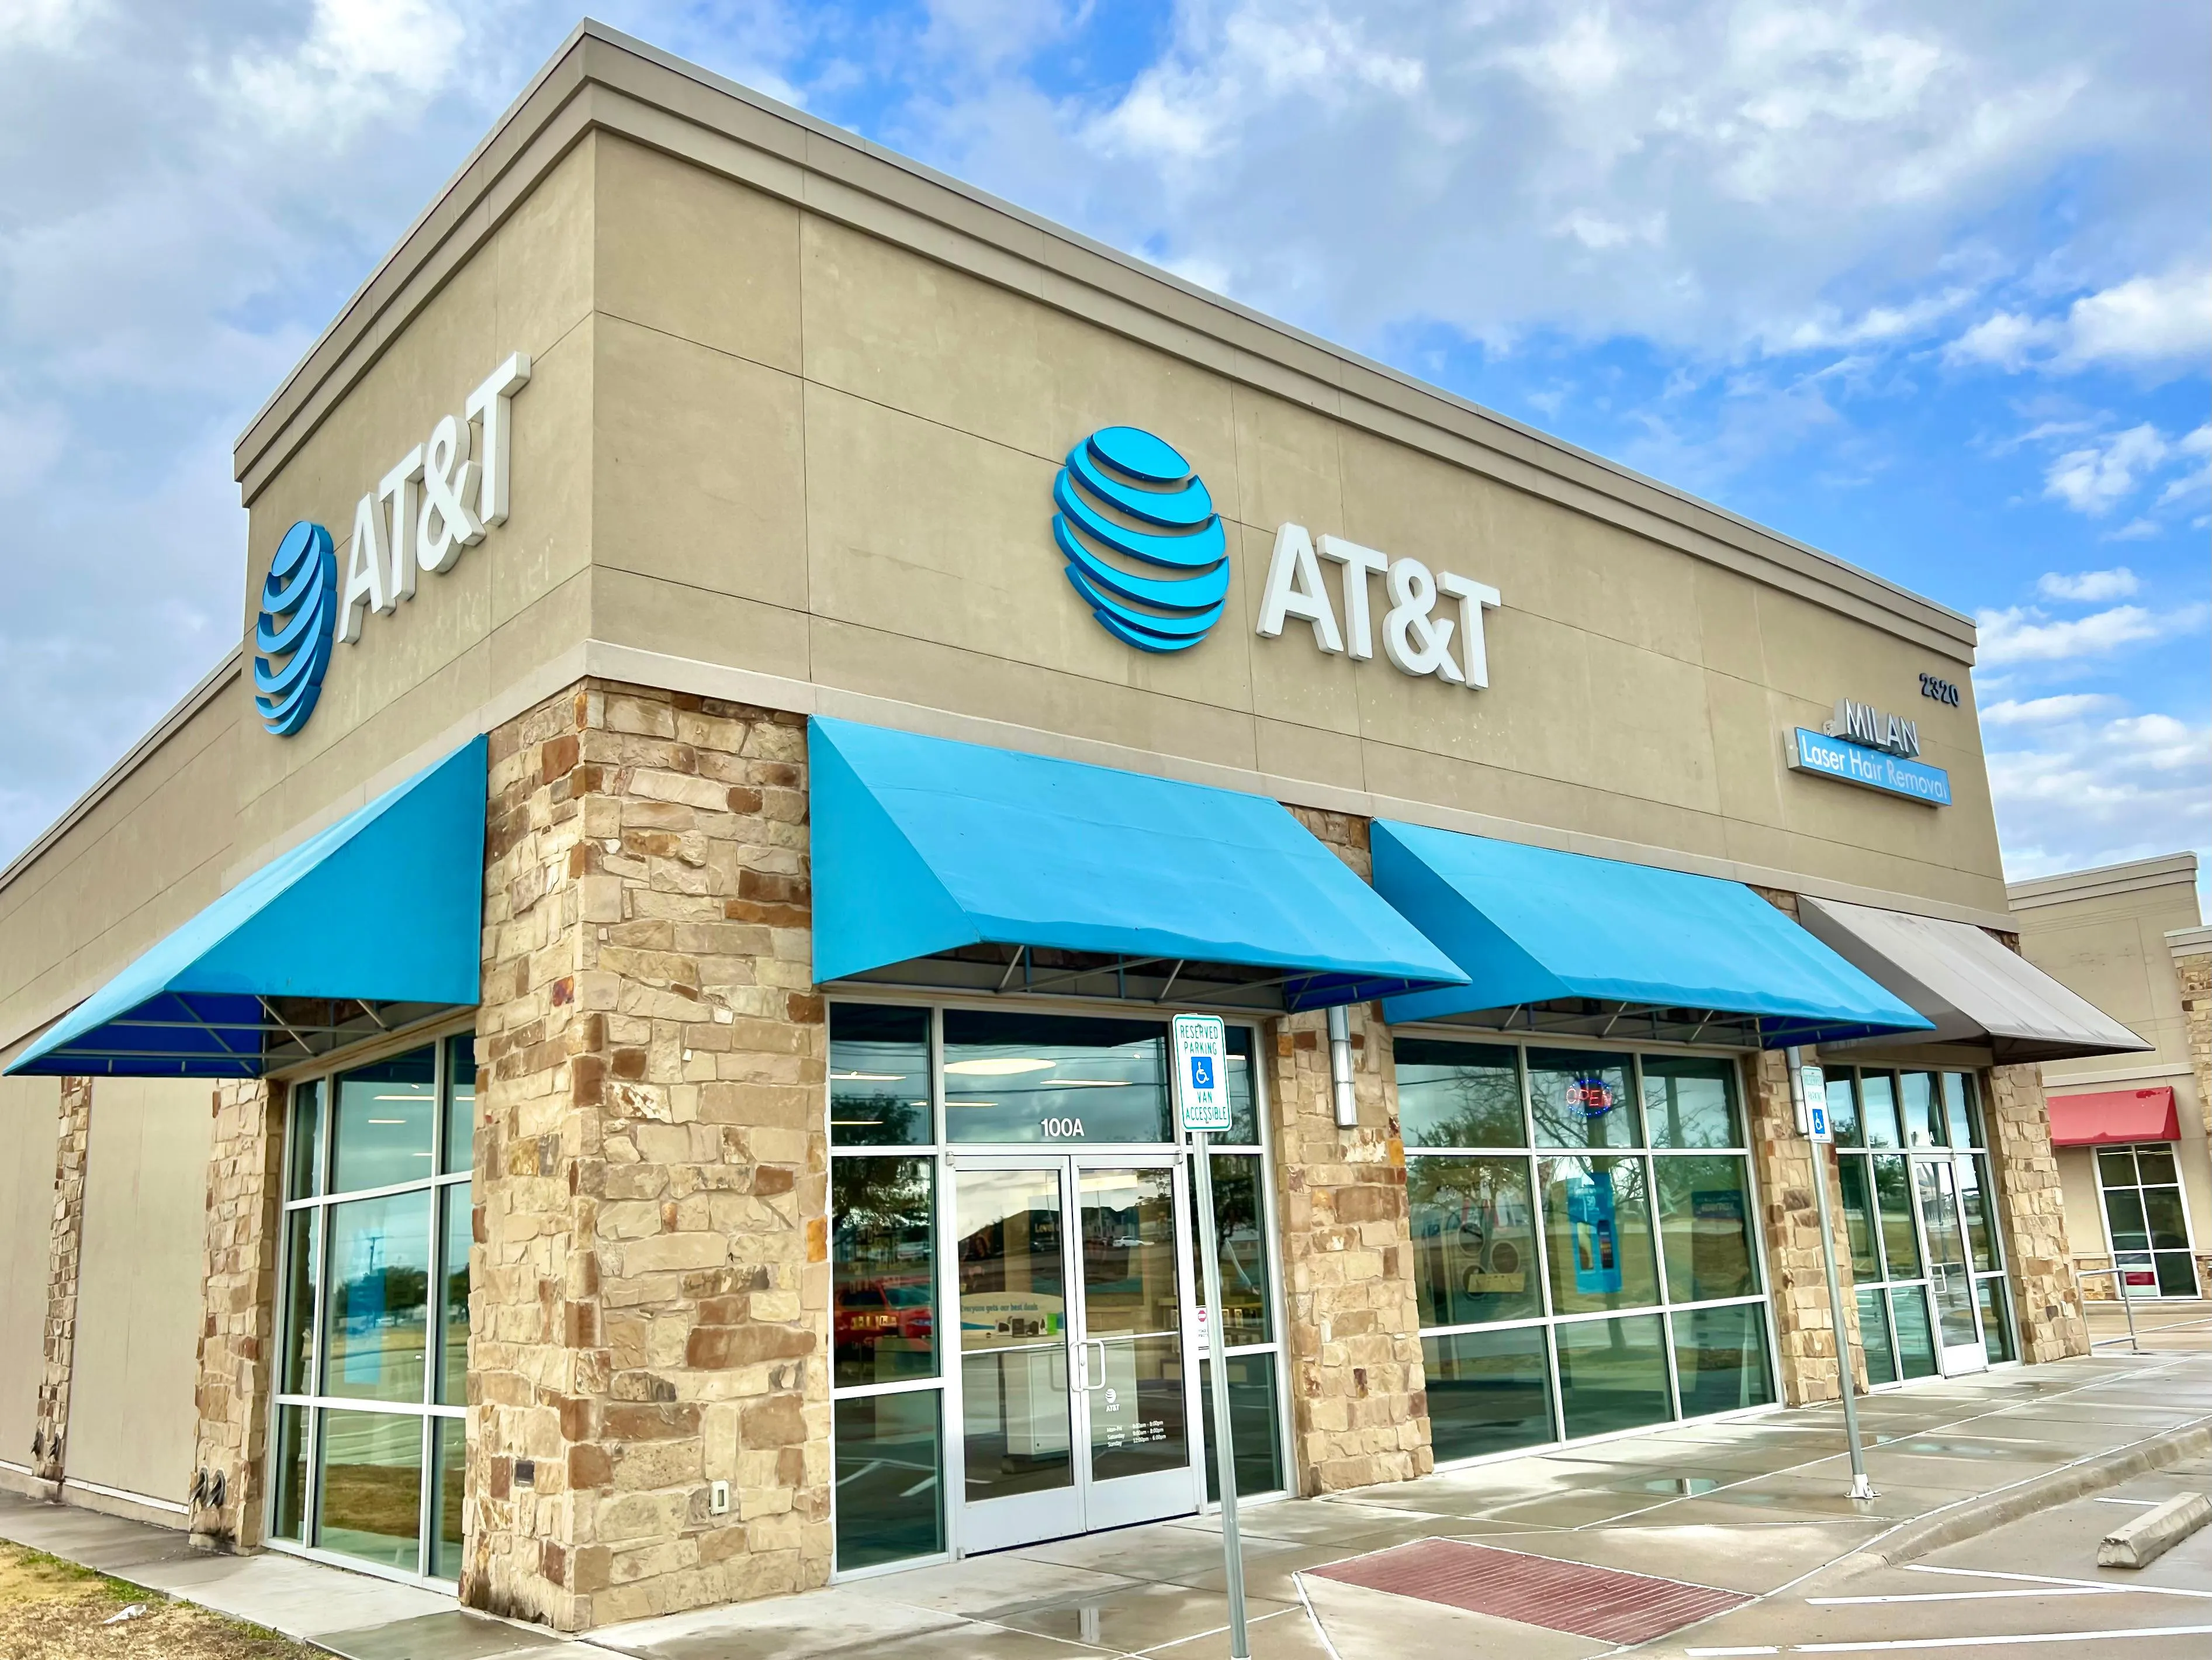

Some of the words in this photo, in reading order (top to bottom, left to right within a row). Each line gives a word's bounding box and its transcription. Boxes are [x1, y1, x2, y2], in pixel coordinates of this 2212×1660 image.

[338, 351, 532, 645] AT&T
[1256, 522, 1501, 691] AT&T
[1919, 673, 1960, 707] 2320
[1844, 697, 1920, 756] MILAN
[1802, 735, 1845, 771] Laser
[1848, 748, 1883, 782] Hair
[1886, 759, 1947, 800] Removal
[1180, 1024, 1218, 1040] RESERVED
[1184, 1041, 1217, 1055] PARKING
[1197, 1091, 1212, 1104] VAN
[1566, 1088, 1612, 1106] OPEN
[1185, 1106, 1227, 1121] ACCESSIBLE
[1041, 1118, 1085, 1137] 100A
[985, 1304, 998, 1314] gets
[1010, 1302, 1023, 1311] best
[1023, 1302, 1039, 1311] deals
[1106, 1404, 1120, 1412] AT&T
